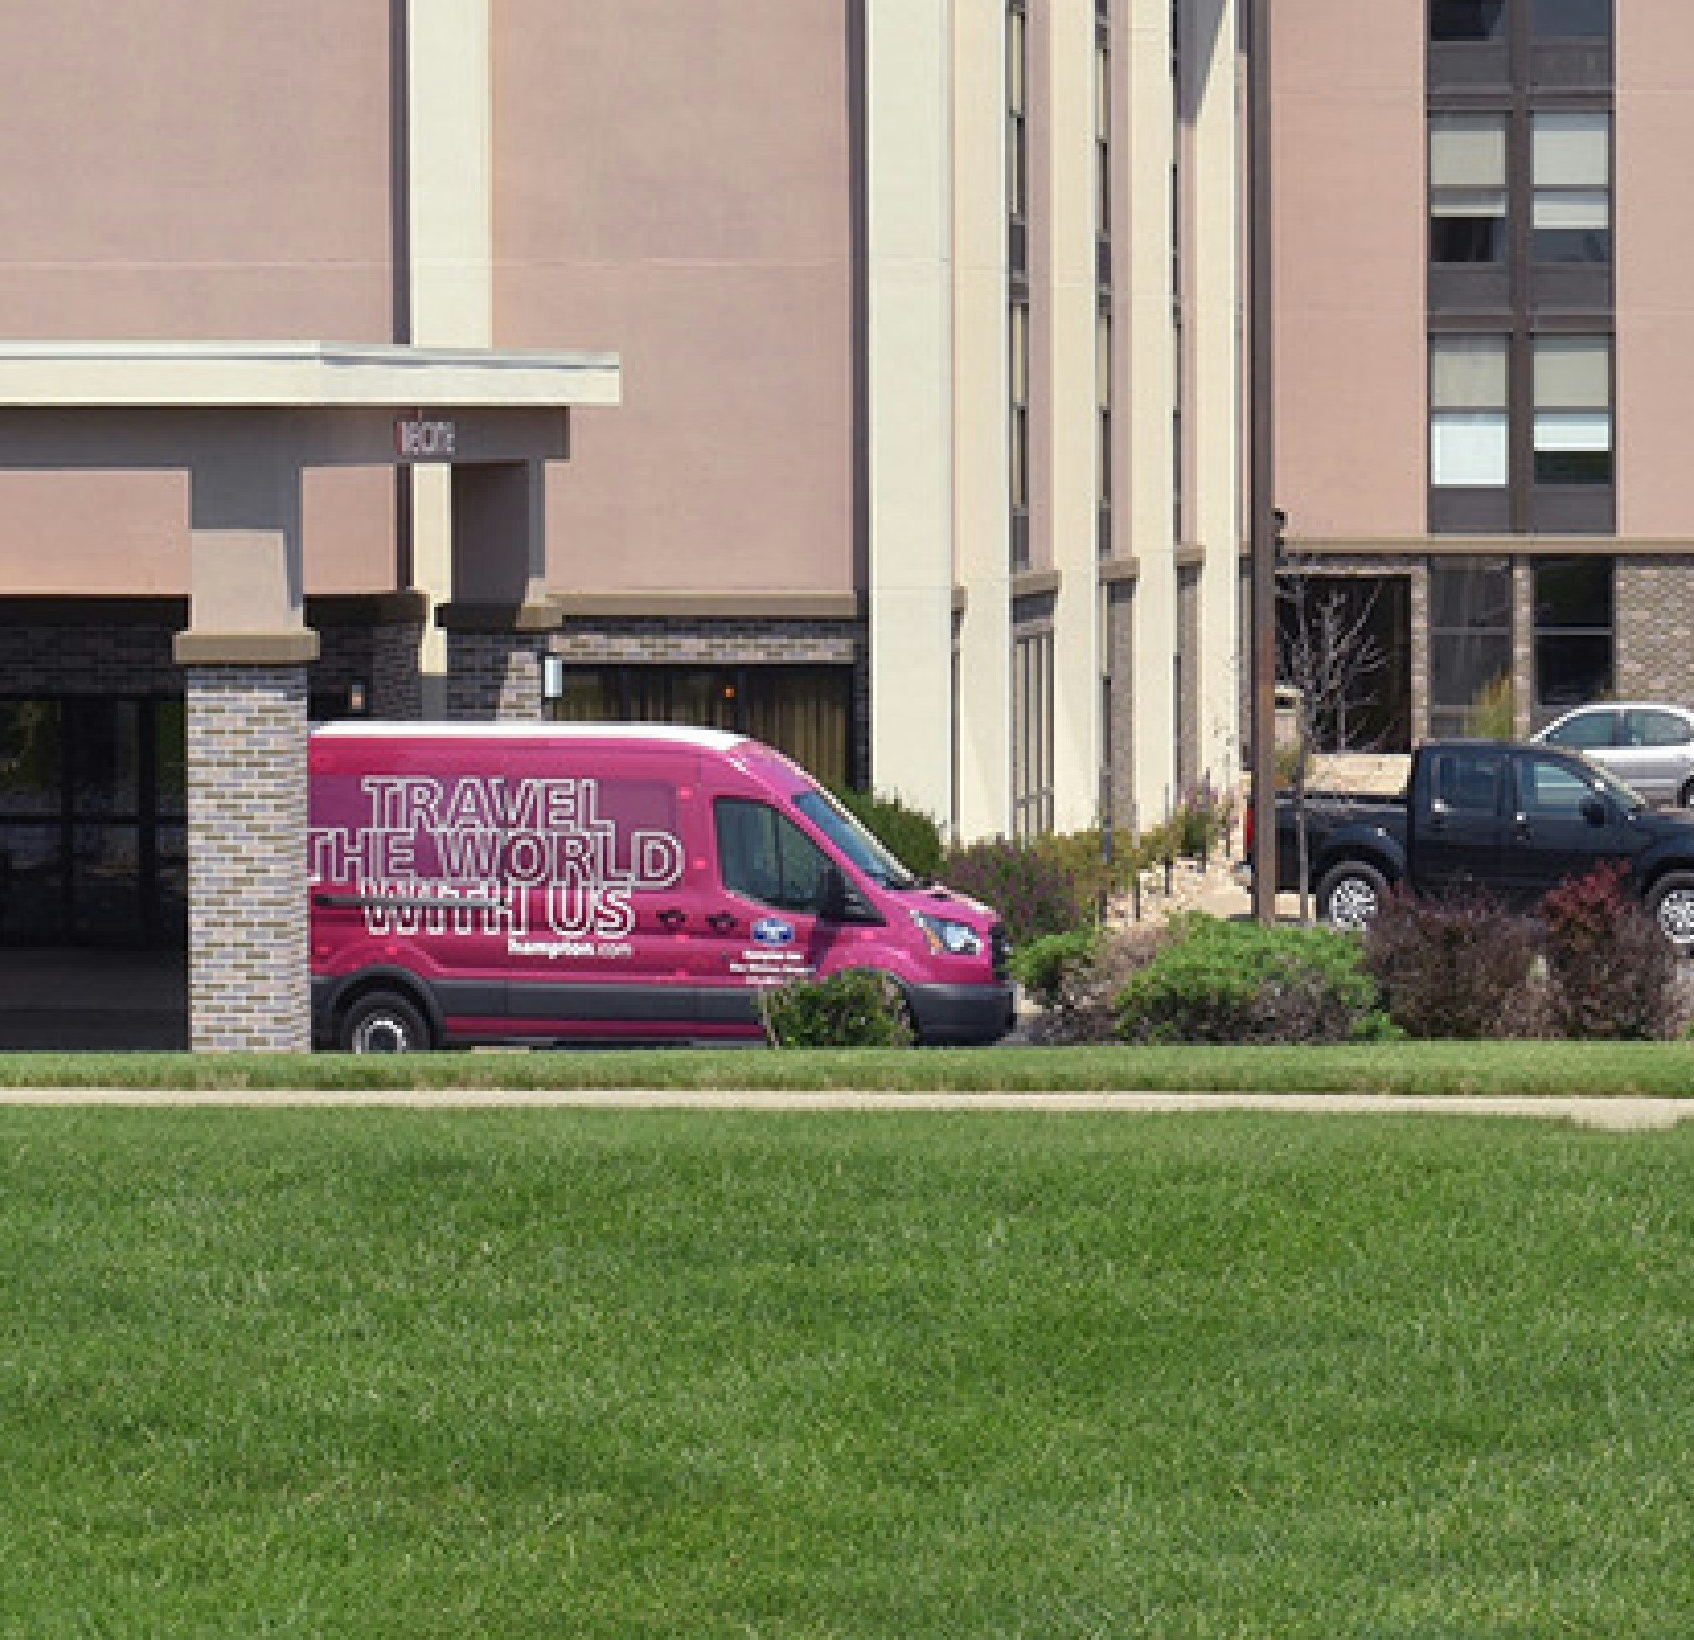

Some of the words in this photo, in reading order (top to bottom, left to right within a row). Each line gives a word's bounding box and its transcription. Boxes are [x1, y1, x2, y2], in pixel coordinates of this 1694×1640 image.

[360, 775, 616, 832] TRAVEL
[308, 826, 417, 884] THE
[434, 828, 685, 889] WORLD
[360, 879, 529, 936] WITH
[546, 881, 634, 938] US
